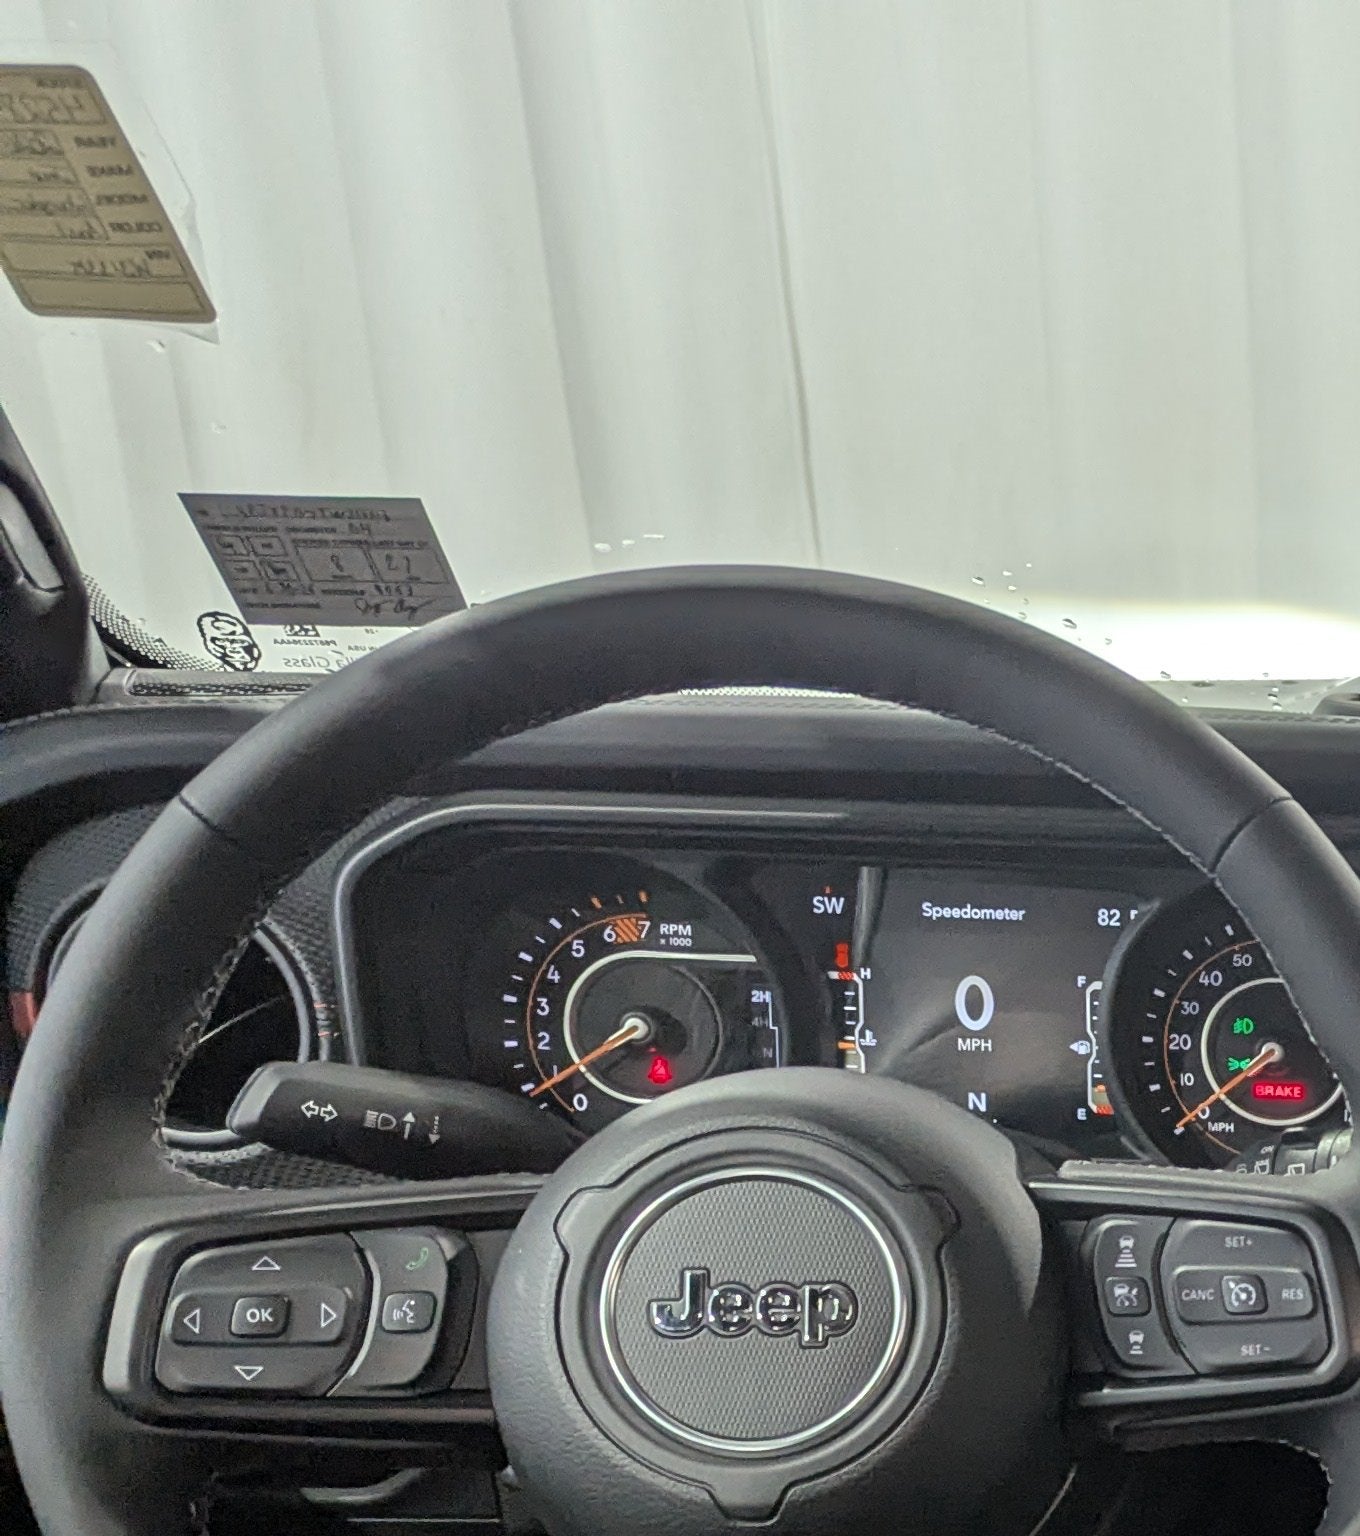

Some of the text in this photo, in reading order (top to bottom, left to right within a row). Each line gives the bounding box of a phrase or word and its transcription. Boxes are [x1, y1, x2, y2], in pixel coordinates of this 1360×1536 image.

[813, 897, 844, 914] SW
[921, 902, 1026, 922] Speedometer
[1097, 909, 1120, 926] 82
[603, 925, 615, 942] 6
[639, 921, 650, 939] 7
[660, 924, 691, 936] RPM
[572, 940, 584, 957] 5
[670, 937, 692, 946] 1000
[1232, 954, 1252, 968] 50
[547, 966, 560, 983] 4
[1199, 970, 1222, 986] 40
[752, 991, 769, 1003] 2H
[954, 975, 994, 1031] 0
[537, 999, 549, 1016] 3
[1181, 1001, 1199, 1016] 30
[538, 1033, 550, 1049] 2
[957, 1038, 992, 1052] MPH
[1169, 1035, 1191, 1051] 20
[1179, 1073, 1194, 1087] 10
[1253, 1084, 1303, 1098] BRAKE
[573, 1094, 587, 1110] 0
[967, 1092, 986, 1112] N
[1208, 1122, 1234, 1134] MPH
[1225, 1236, 1252, 1249] SET+
[1181, 1289, 1216, 1301] CANC
[1281, 1288, 1304, 1301] RES
[245, 1308, 273, 1323] OK
[649, 1266, 858, 1349] Jeep
